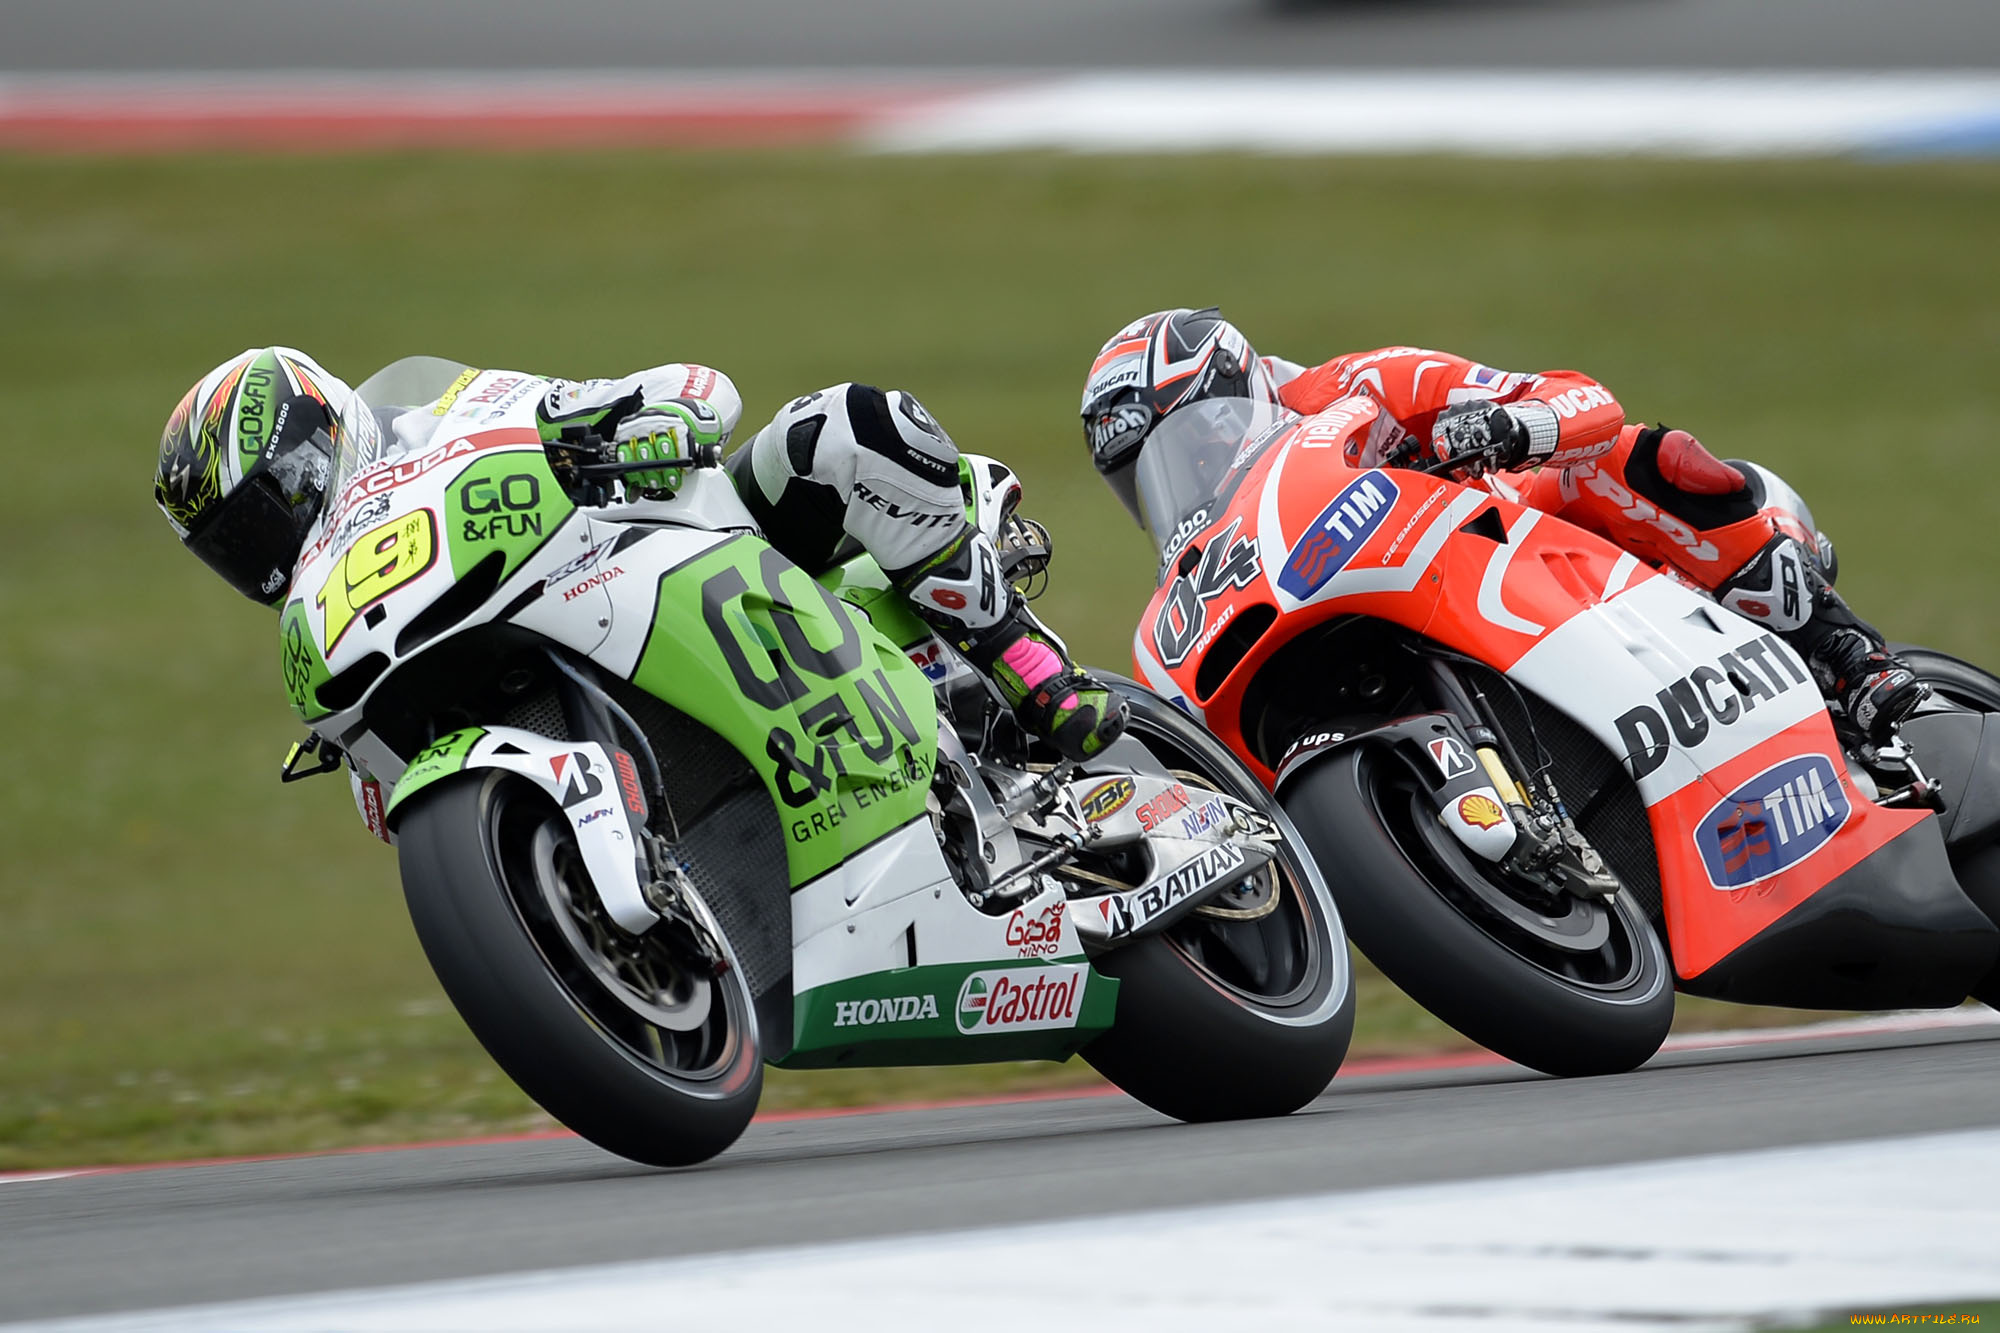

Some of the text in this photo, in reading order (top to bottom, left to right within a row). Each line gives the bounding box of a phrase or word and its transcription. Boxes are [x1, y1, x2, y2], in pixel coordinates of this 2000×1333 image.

[240, 368, 275, 456] GO&FUN
[1092, 371, 1138, 397] DUCATI
[1095, 408, 1146, 454] Airoh
[1378, 426, 1402, 457] DUCATI
[460, 473, 541, 516] GO
[1324, 479, 1387, 543] TIM
[463, 512, 543, 542] &FUN
[1162, 509, 1208, 566] kobo
[1381, 484, 1447, 565] DESMOSEDICI
[316, 506, 440, 660] 19
[563, 566, 625, 602] HONDA
[1153, 515, 1263, 669] 04
[701, 547, 863, 711] GO
[1195, 604, 1236, 654] DUCATI
[1614, 634, 1808, 781] DUCATI
[766, 668, 921, 809] &FUN
[1303, 732, 1345, 746] ups
[615, 751, 645, 816] SHOWA
[1136, 784, 1191, 832] SHOWA
[1763, 767, 1836, 846] TIM
[1138, 842, 1242, 920] BATTLAX
[834, 994, 939, 1028] HONDA
[986, 971, 1079, 1025] Castrol
